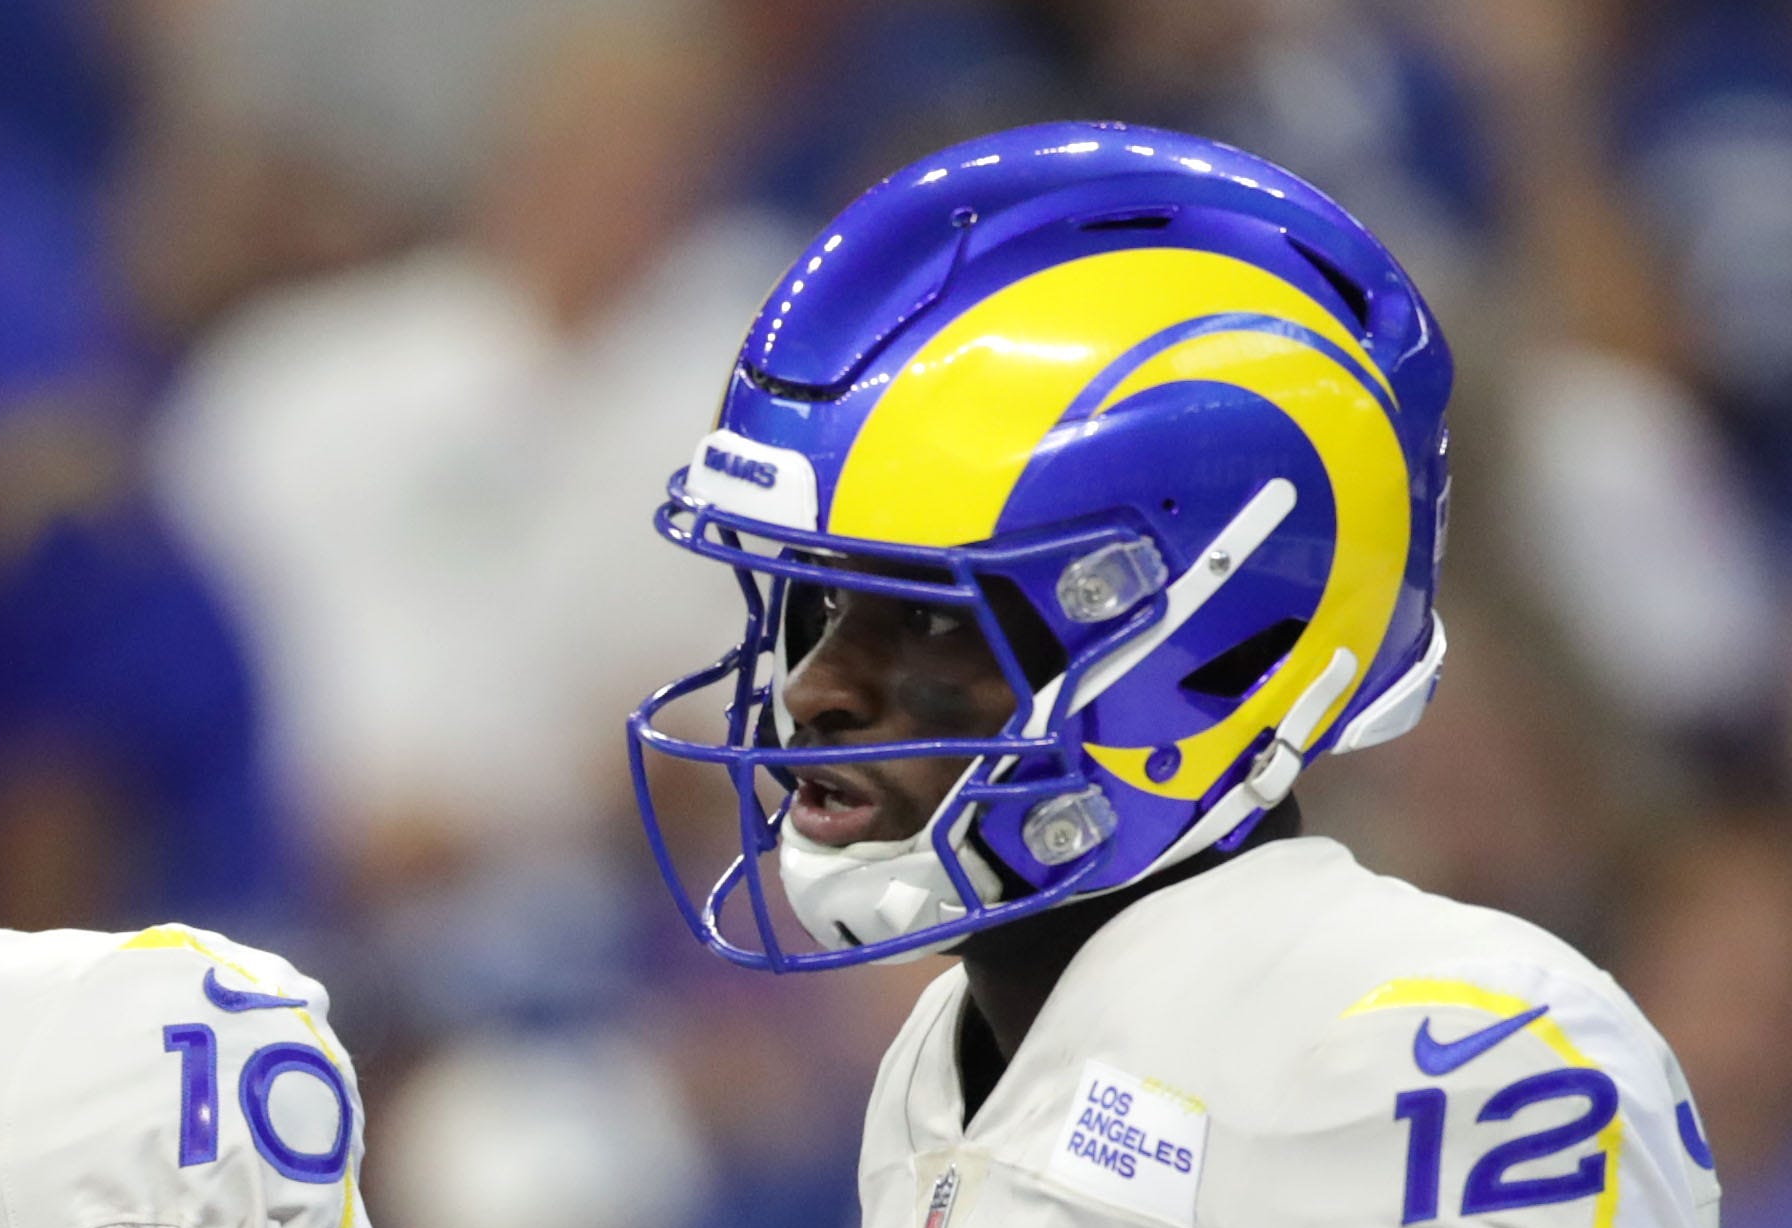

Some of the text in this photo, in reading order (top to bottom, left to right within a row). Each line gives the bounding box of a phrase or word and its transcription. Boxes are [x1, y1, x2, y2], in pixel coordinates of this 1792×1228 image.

[162, 1022, 354, 1184] 10
[1087, 1080, 1134, 1117] LOS
[1066, 1130, 1138, 1179] RAMS
[1076, 1107, 1194, 1175] ANGELES
[1394, 1067, 1619, 1227] 12
